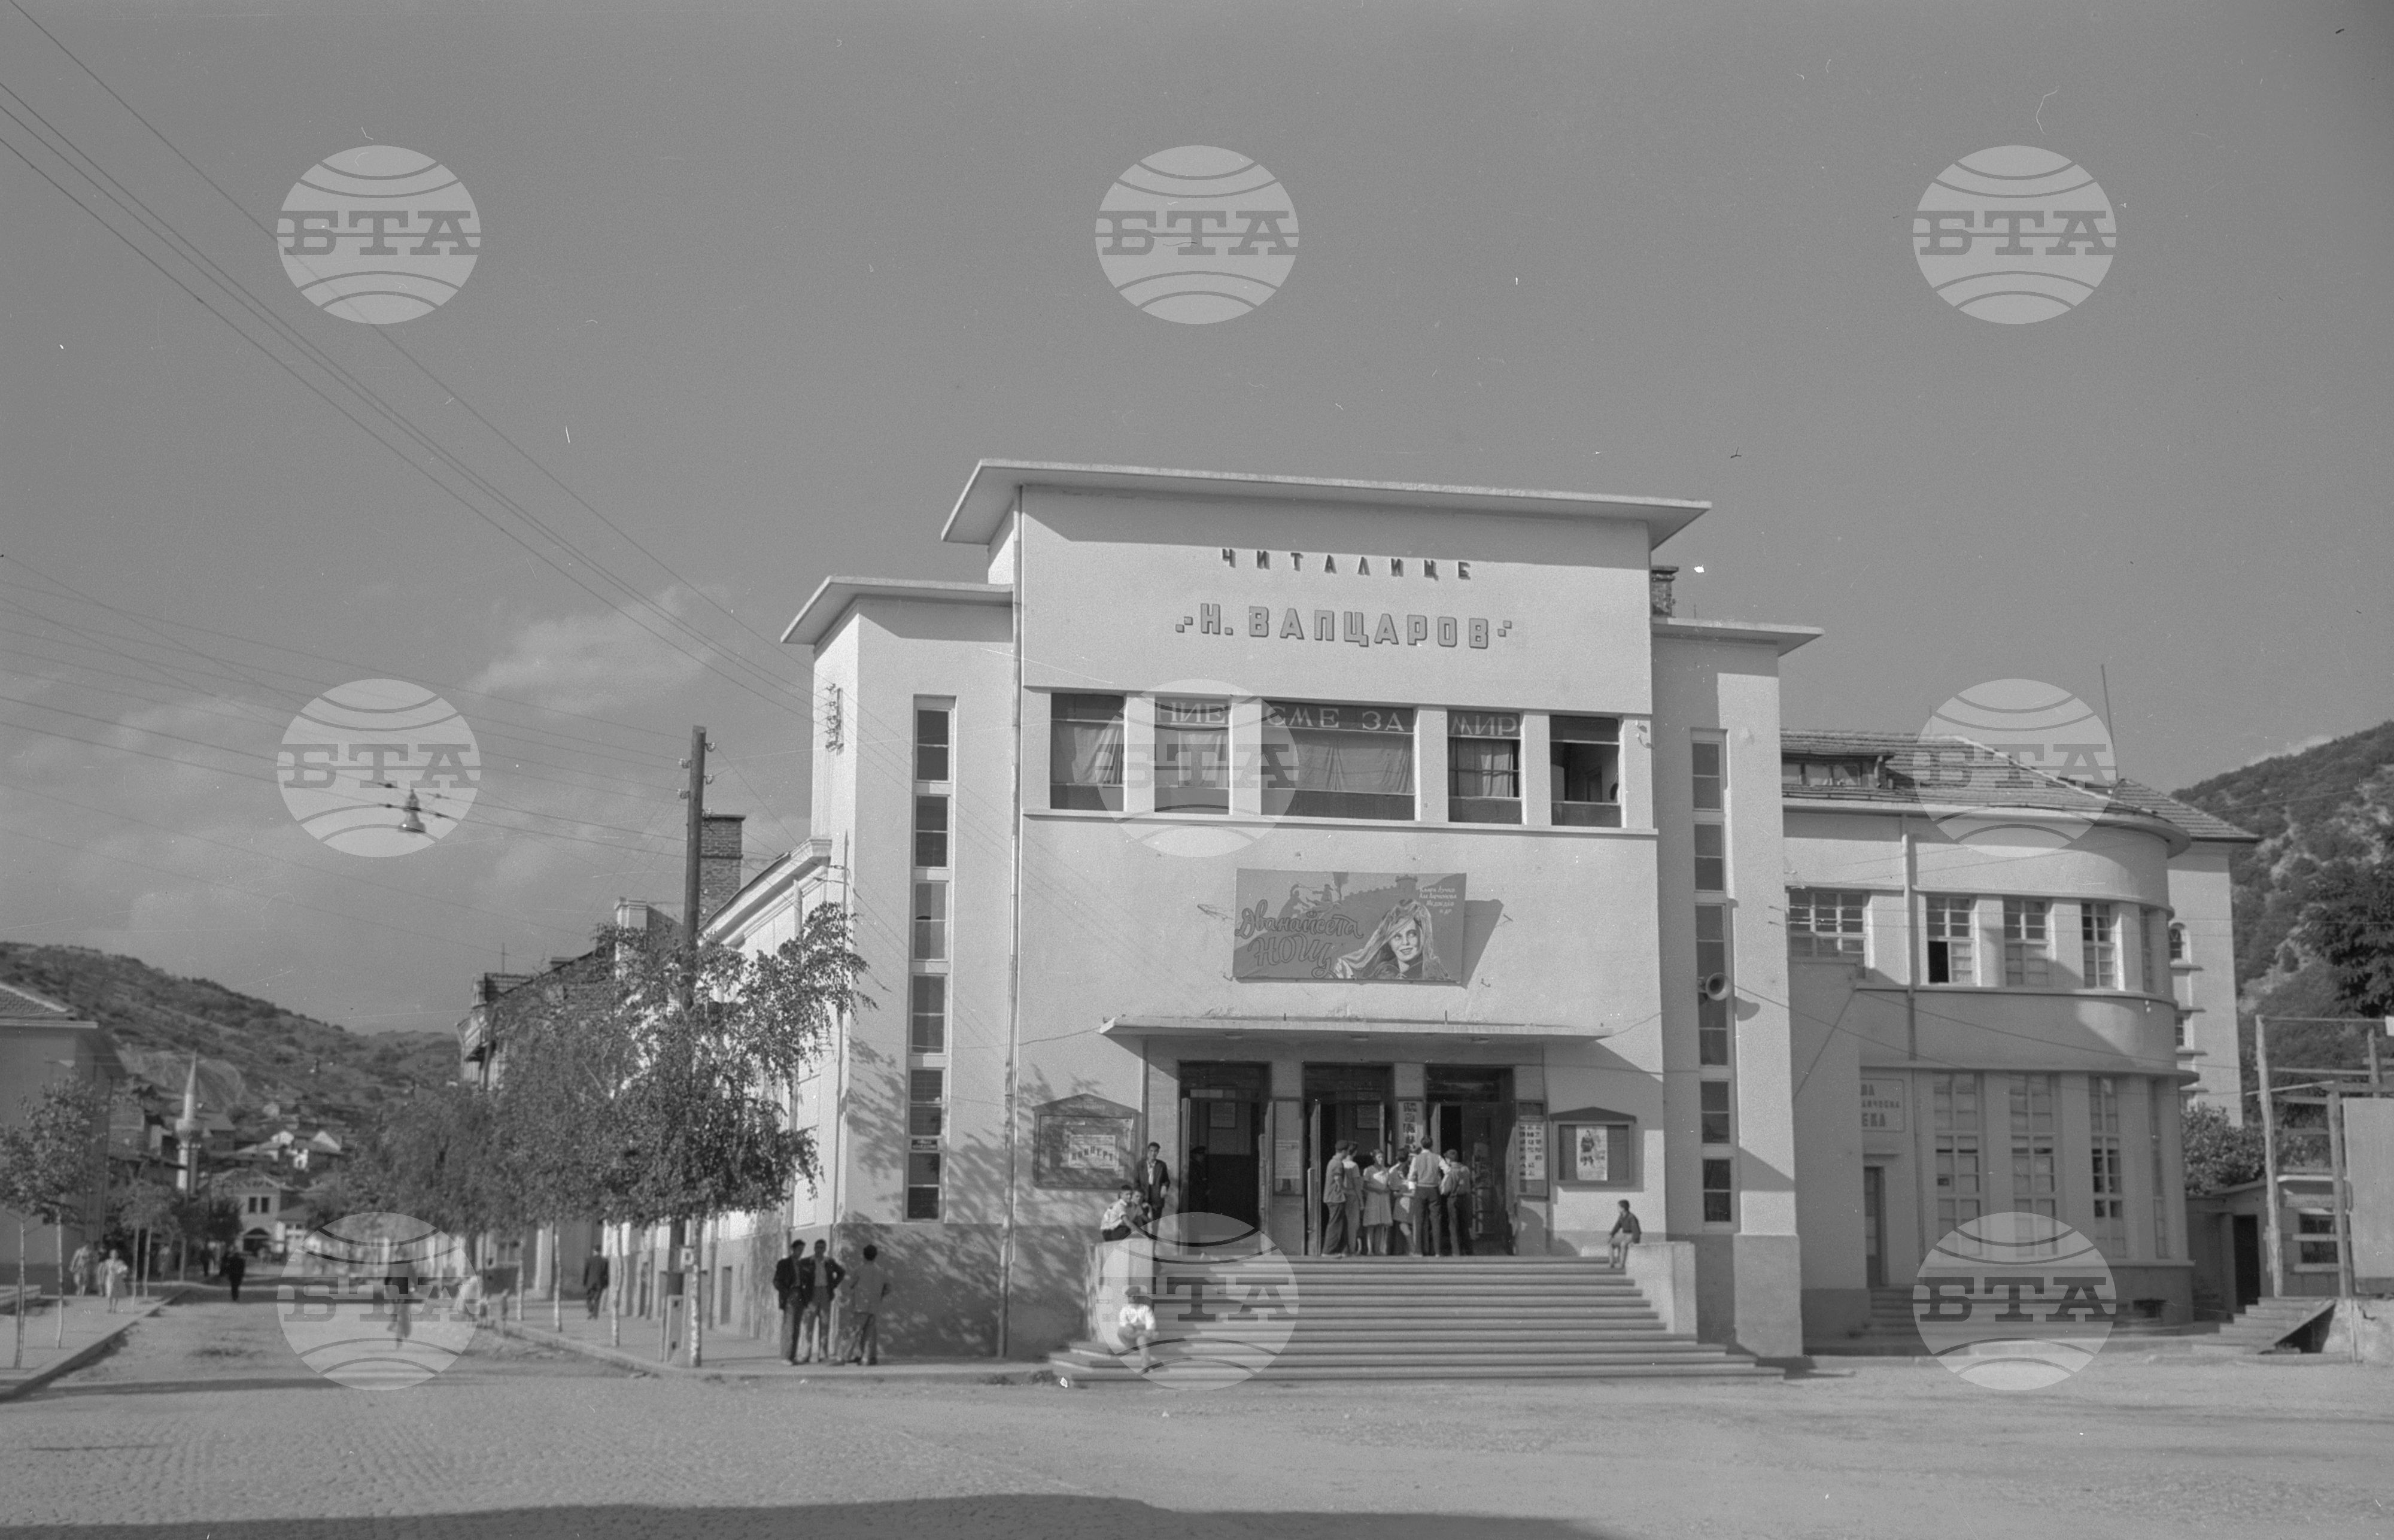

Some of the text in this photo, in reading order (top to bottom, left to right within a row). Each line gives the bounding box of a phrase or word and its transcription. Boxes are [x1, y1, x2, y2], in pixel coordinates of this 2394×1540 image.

[1222, 548, 1471, 581] ЧИТАЛИЩЕ
[1156, 700, 1517, 736] НИЕ СМЕ ЗА МИР
